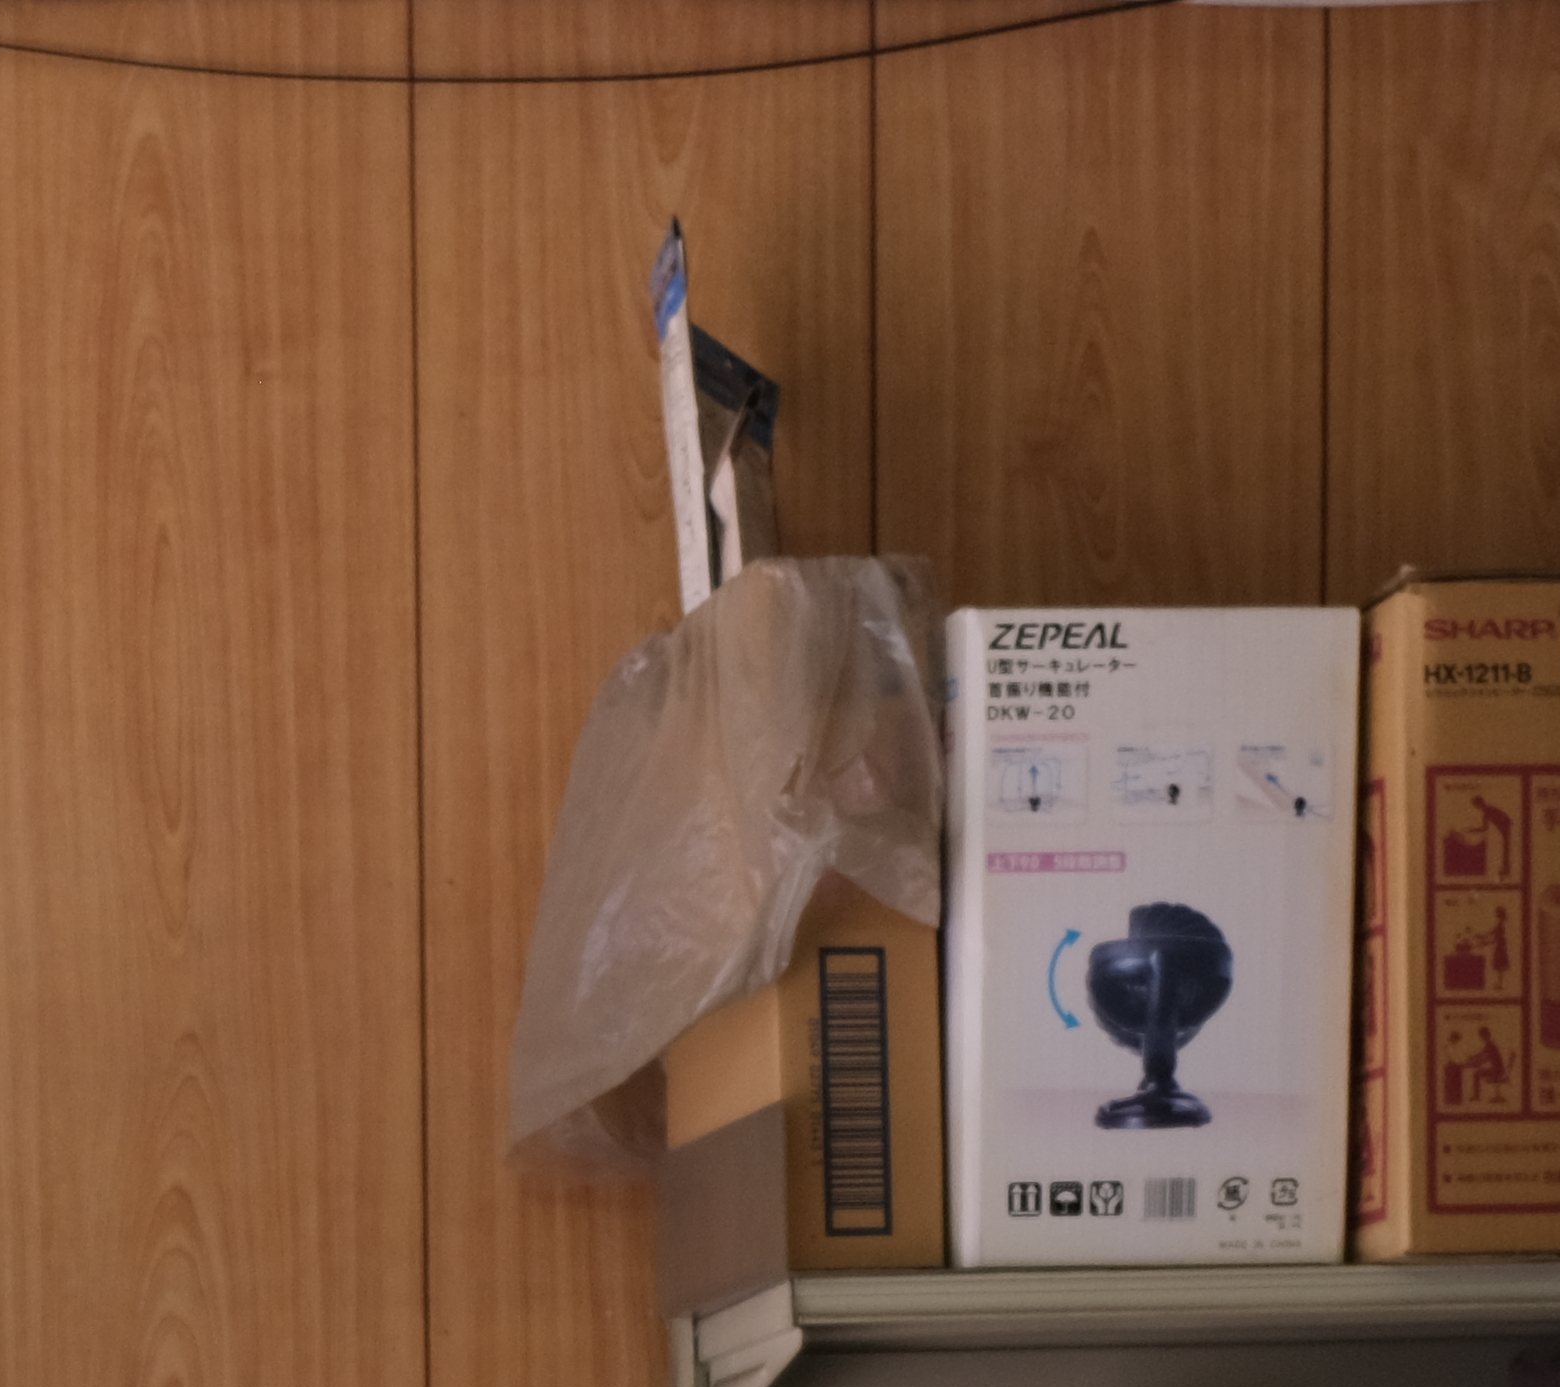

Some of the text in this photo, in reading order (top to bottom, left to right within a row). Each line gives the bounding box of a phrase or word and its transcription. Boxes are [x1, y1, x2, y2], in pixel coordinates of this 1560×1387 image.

[988, 621, 1130, 651] ZEPEAL
[1423, 618, 1557, 641] SHARP
[987, 658, 1138, 675] U型サーキュレーター
[1423, 662, 1533, 685] HX-1211-B
[987, 681, 1091, 699] 首振り機能付
[987, 704, 1076, 722] DKW-20
